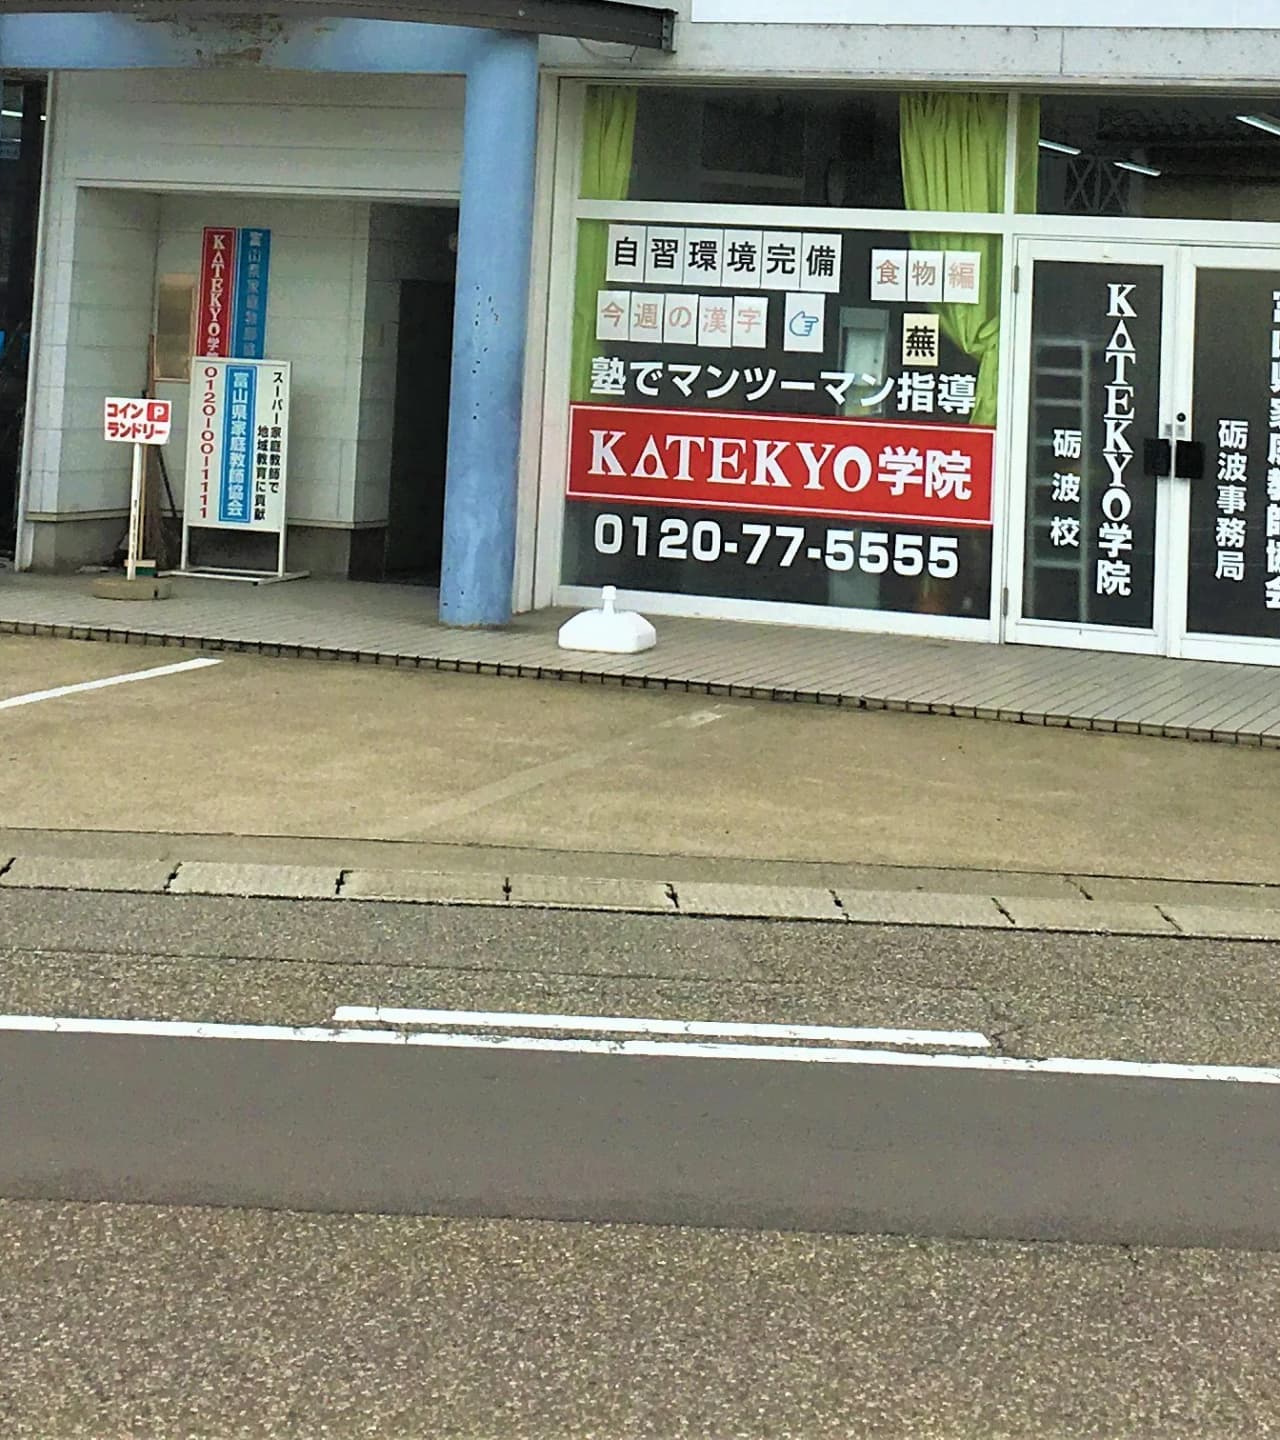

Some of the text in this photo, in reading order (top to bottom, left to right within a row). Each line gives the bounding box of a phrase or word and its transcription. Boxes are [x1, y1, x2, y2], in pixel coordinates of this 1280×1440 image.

[612, 236, 840, 278] 自習環境完備
[875, 258, 975, 290] 食物編
[600, 301, 763, 334] 今週の漢字
[106, 402, 144, 420] コイン
[589, 356, 977, 415] 塾でマンツーマン指導
[105, 421, 167, 439] ランドリー
[199, 366, 219, 519] 0120-00-1111
[226, 372, 250, 517] 富山県家庭教師協会
[267, 371, 284, 494] スーパー家庭教師で
[587, 428, 973, 501] KATEKYO学院
[1095, 283, 1137, 597] KATEKYO学院
[253, 424, 269, 521] 地域教育に貢献
[1050, 429, 1082, 548] 砺波校
[1214, 419, 1249, 582] 砺波事務局
[594, 513, 960, 579] 0120-77-5555
